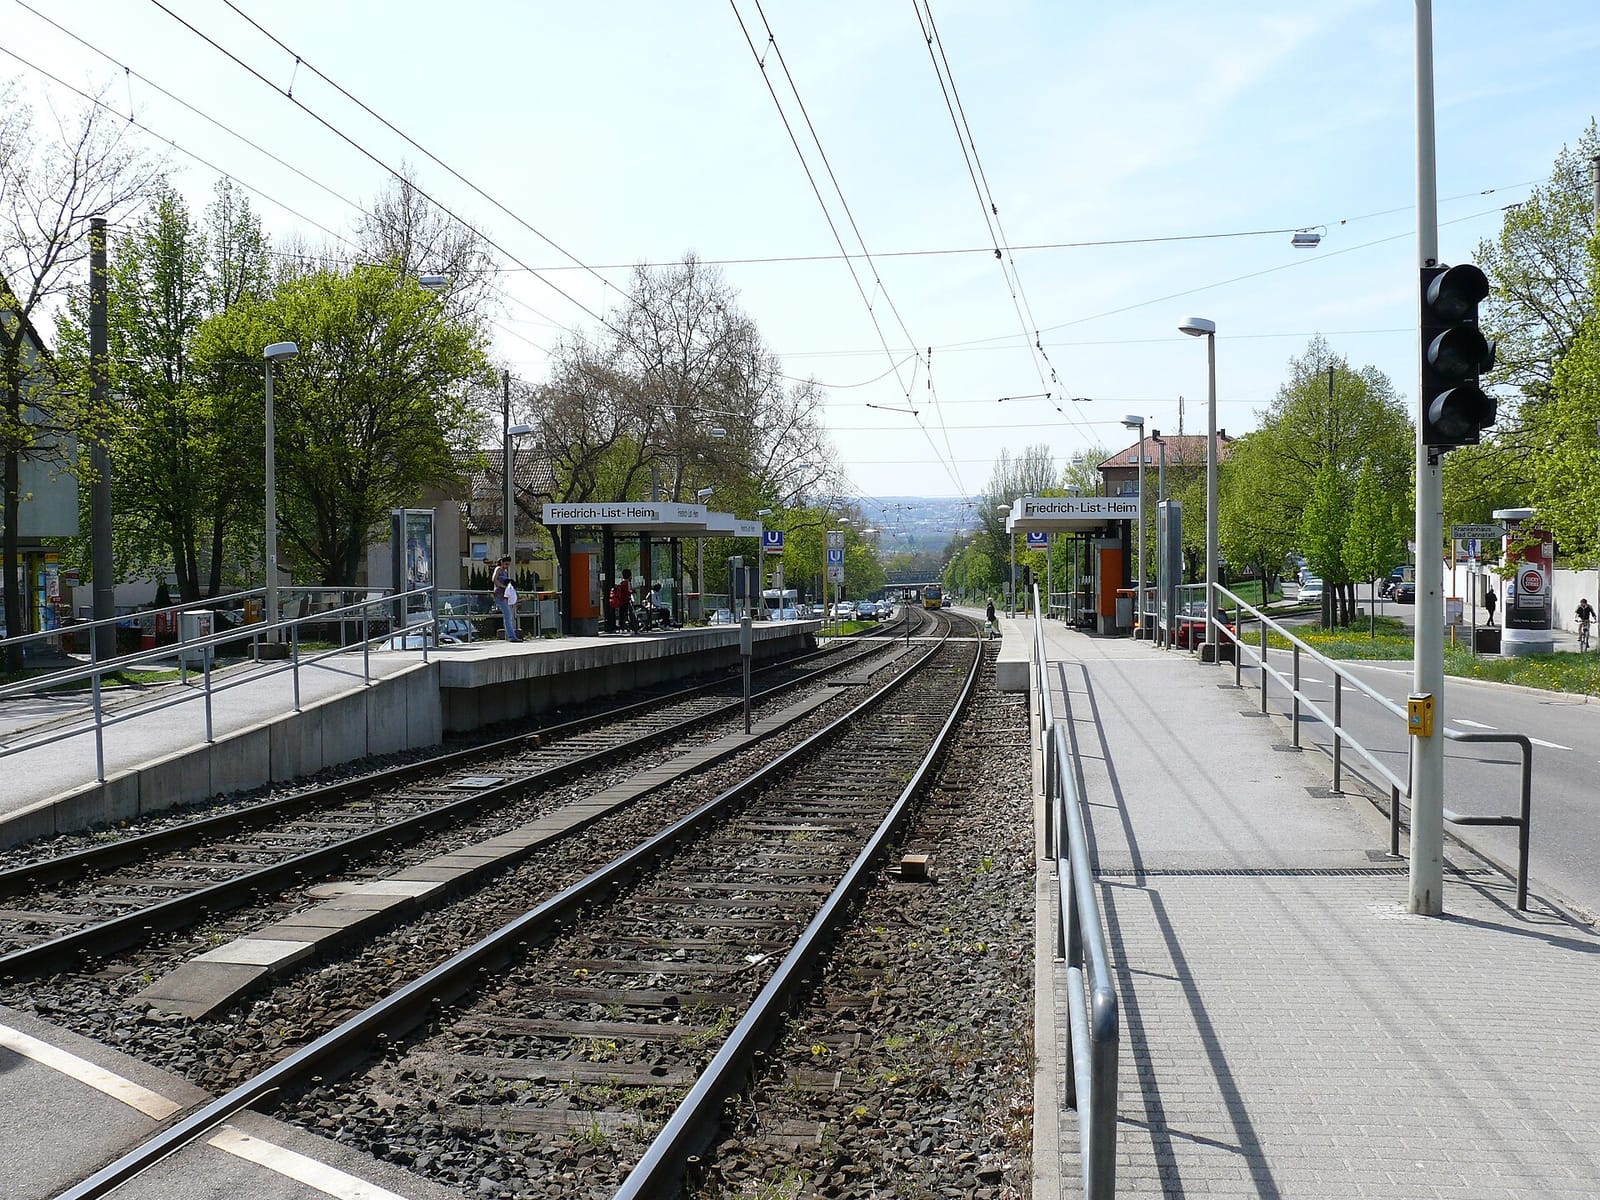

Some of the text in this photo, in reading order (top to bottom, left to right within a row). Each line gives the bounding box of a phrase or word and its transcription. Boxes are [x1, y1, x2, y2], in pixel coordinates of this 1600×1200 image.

[551, 507, 655, 519] Friedrich-List-Heim
[1025, 502, 1137, 513] Friedrich-List-Heim
[768, 532, 779, 543] U
[830, 550, 841, 561] U
